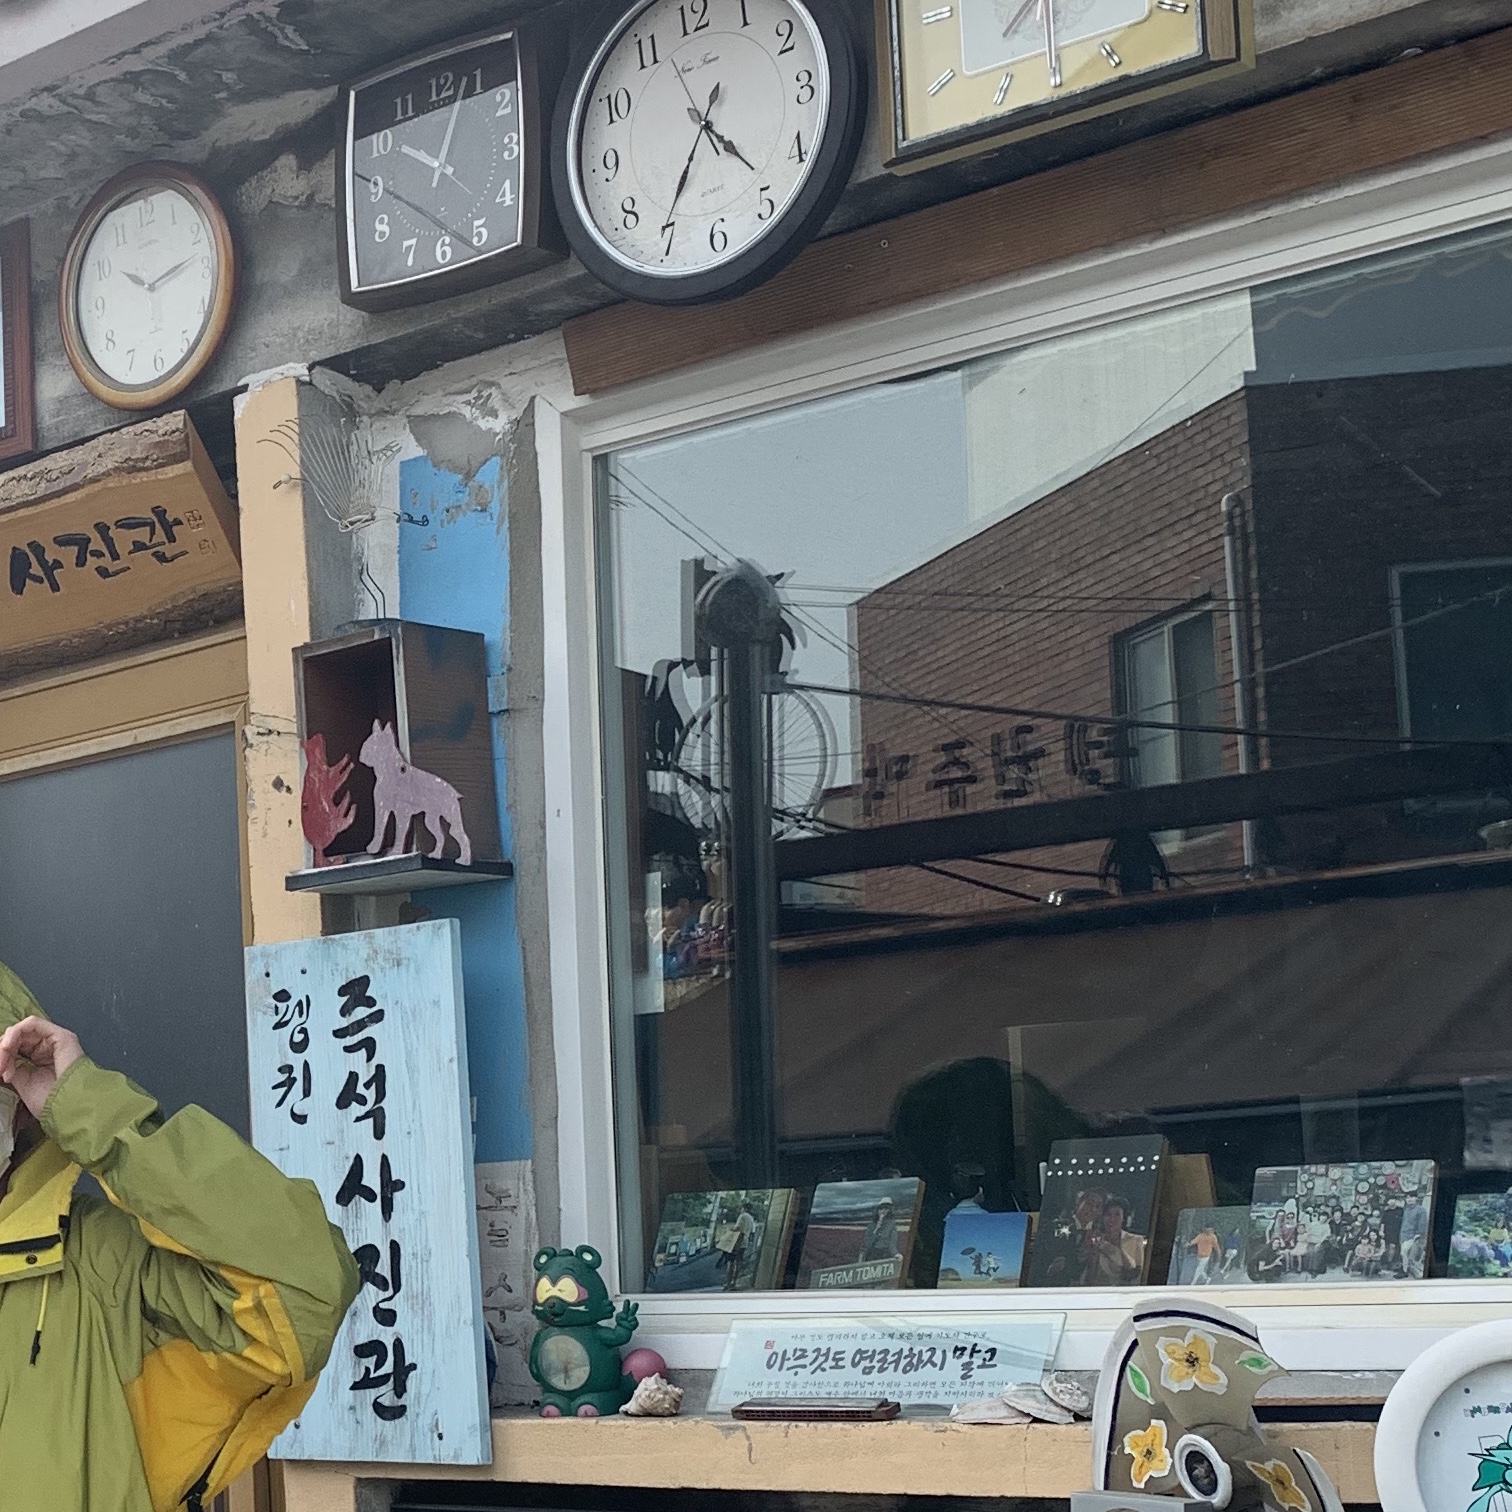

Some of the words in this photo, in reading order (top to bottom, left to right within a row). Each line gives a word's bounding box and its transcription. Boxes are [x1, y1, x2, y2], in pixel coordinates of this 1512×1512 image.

[677, 0, 711, 39] 12
[739, 0, 752, 29] 1
[635, 32, 660, 72] 11
[775, 19, 796, 57] 2
[428, 71, 454, 102] 12
[472, 67, 485, 95] 1
[795, 69, 815, 105] 3
[393, 92, 415, 121] 11
[495, 88, 512, 117] 2
[603, 87, 631, 126] 10
[370, 129, 393, 159] 10
[502, 132, 519, 161] 3
[788, 130, 807, 165] 4
[603, 147, 620, 182] 9
[368, 175, 384, 203] 9
[494, 178, 516, 207] 4
[758, 185, 775, 221] 5
[138, 201, 155, 228] 12
[170, 203, 177, 225] 1
[374, 213, 390, 243] 8
[621, 196, 639, 231] 8
[113, 223, 128, 247] 11
[190, 222, 201, 246] 2
[472, 217, 488, 247] 5
[660, 221, 675, 256] 7
[709, 217, 728, 253] 6
[402, 237, 418, 267] 7
[435, 236, 452, 264] 6
[96, 257, 112, 281] 10
[201, 255, 212, 280] 3
[94, 295, 105, 319] 9
[197, 295, 208, 315] 4
[105, 329, 116, 351] 8
[180, 329, 190, 354] 5
[125, 348, 136, 371] 7
[153, 349, 165, 372] 6
[9, 505, 189, 596] 사진관
[818, 1269, 853, 1288] FARM
[855, 1263, 895, 1281] TOMITA
[766, 1346, 846, 1376] 아무것도
[851, 1346, 947, 1376] 염려하지
[952, 1342, 998, 1381] 말고
